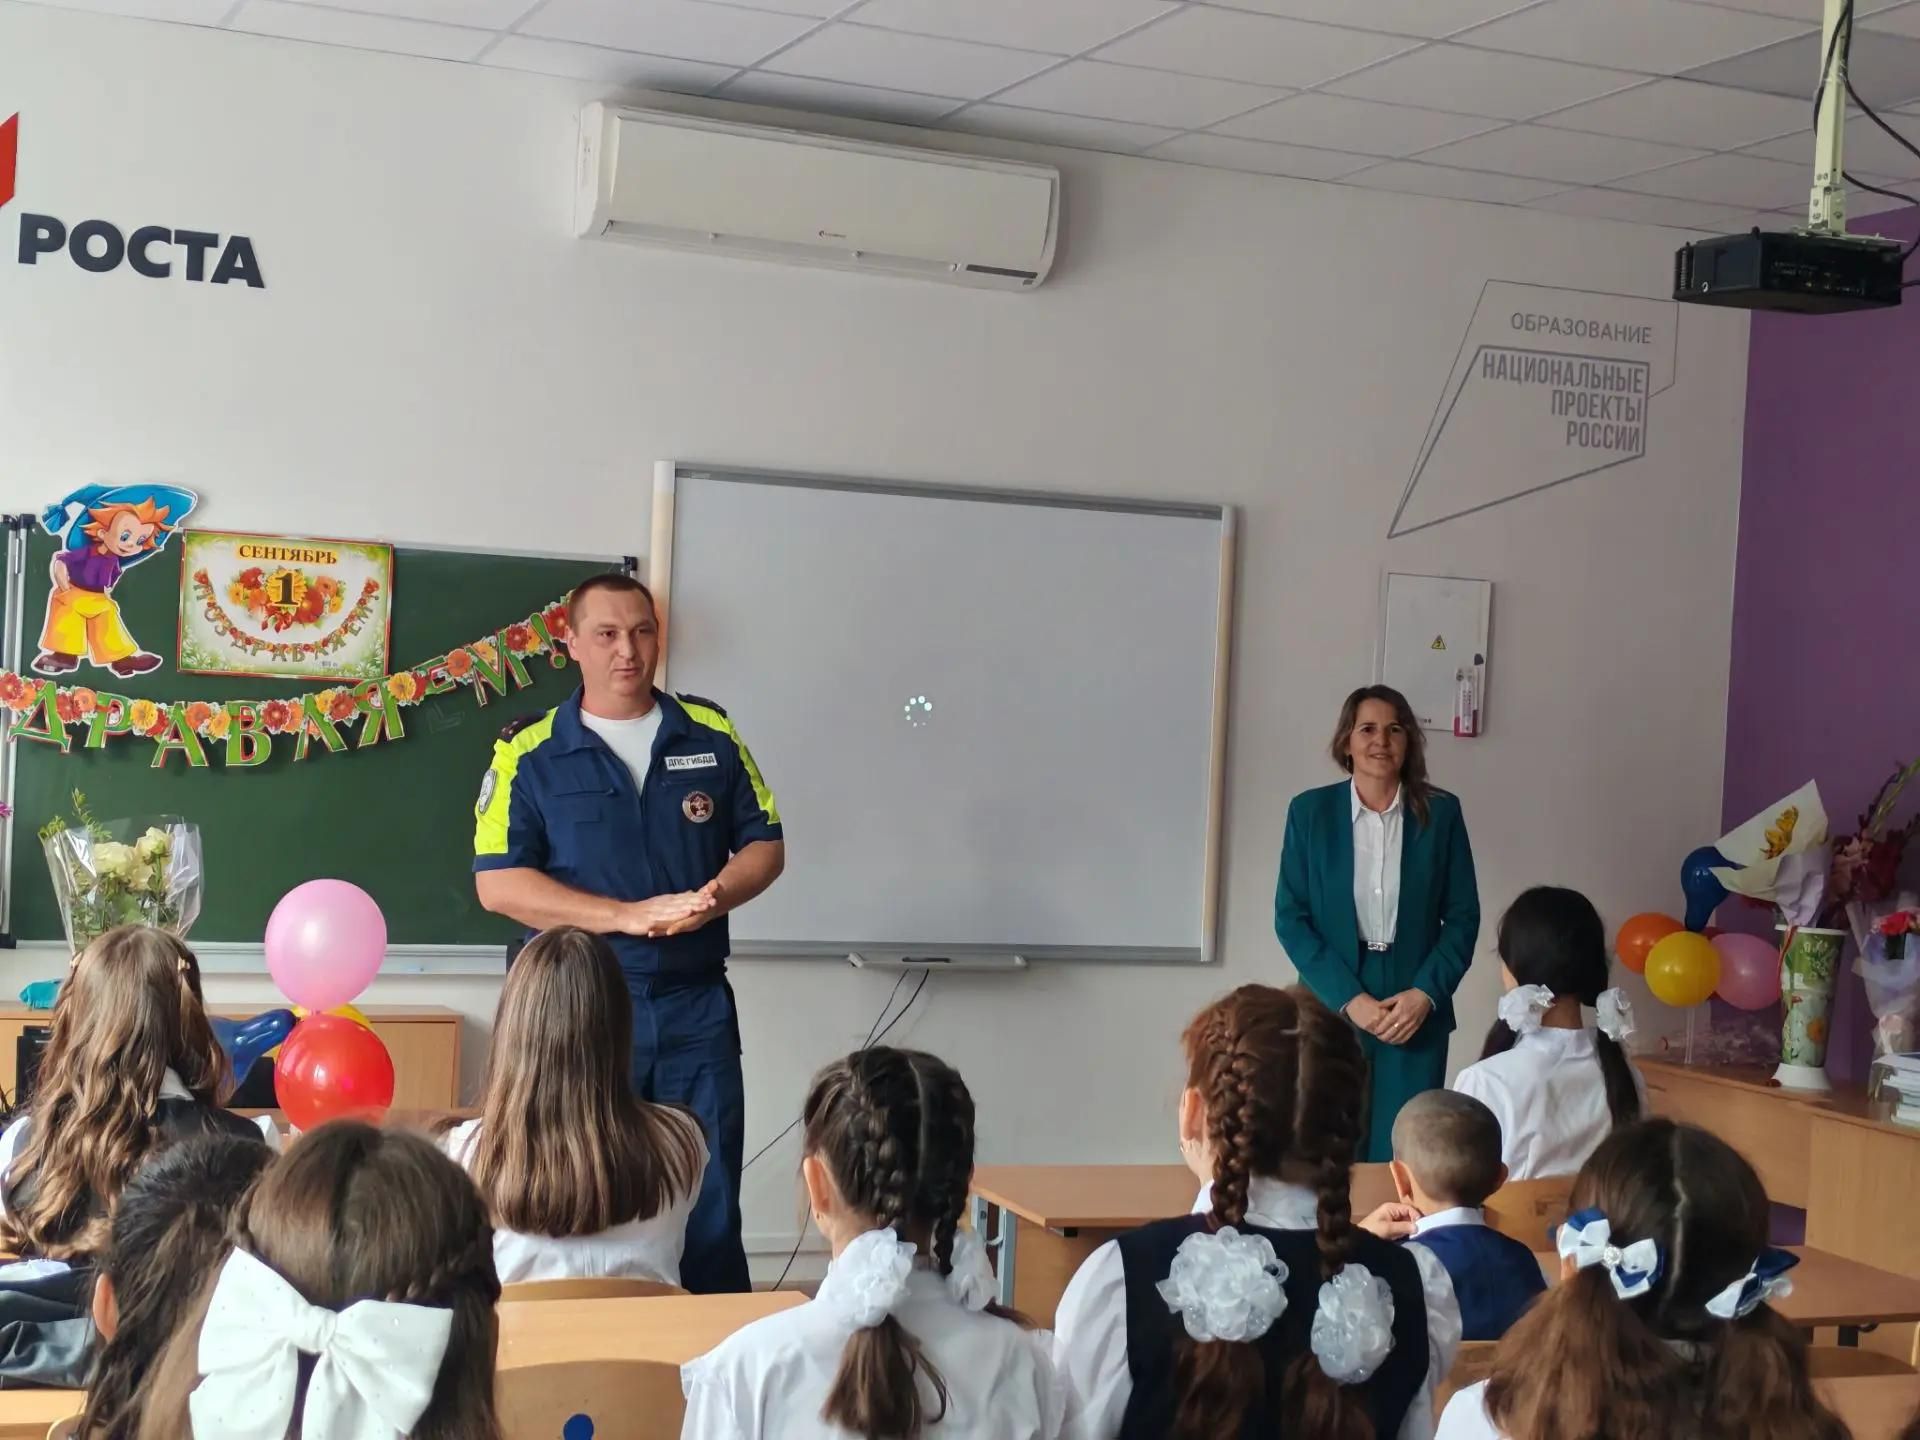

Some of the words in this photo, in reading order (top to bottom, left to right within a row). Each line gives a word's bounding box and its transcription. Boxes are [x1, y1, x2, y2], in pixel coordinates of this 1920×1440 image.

[18, 212, 265, 289] РОСТА
[1511, 312, 1652, 344] ОБРАЗОВАНИЕ
[1482, 351, 1644, 394] НАЦИОНАЛЬНЫЕ
[1551, 389, 1643, 423] ПРОЕКТЫ
[1566, 420, 1640, 453] РОССИИ
[239, 543, 337, 565] СЕНТЯБРЬ
[275, 572, 299, 606] 1
[668, 758, 685, 768] ДПС
[686, 755, 715, 766] ГИБДД
